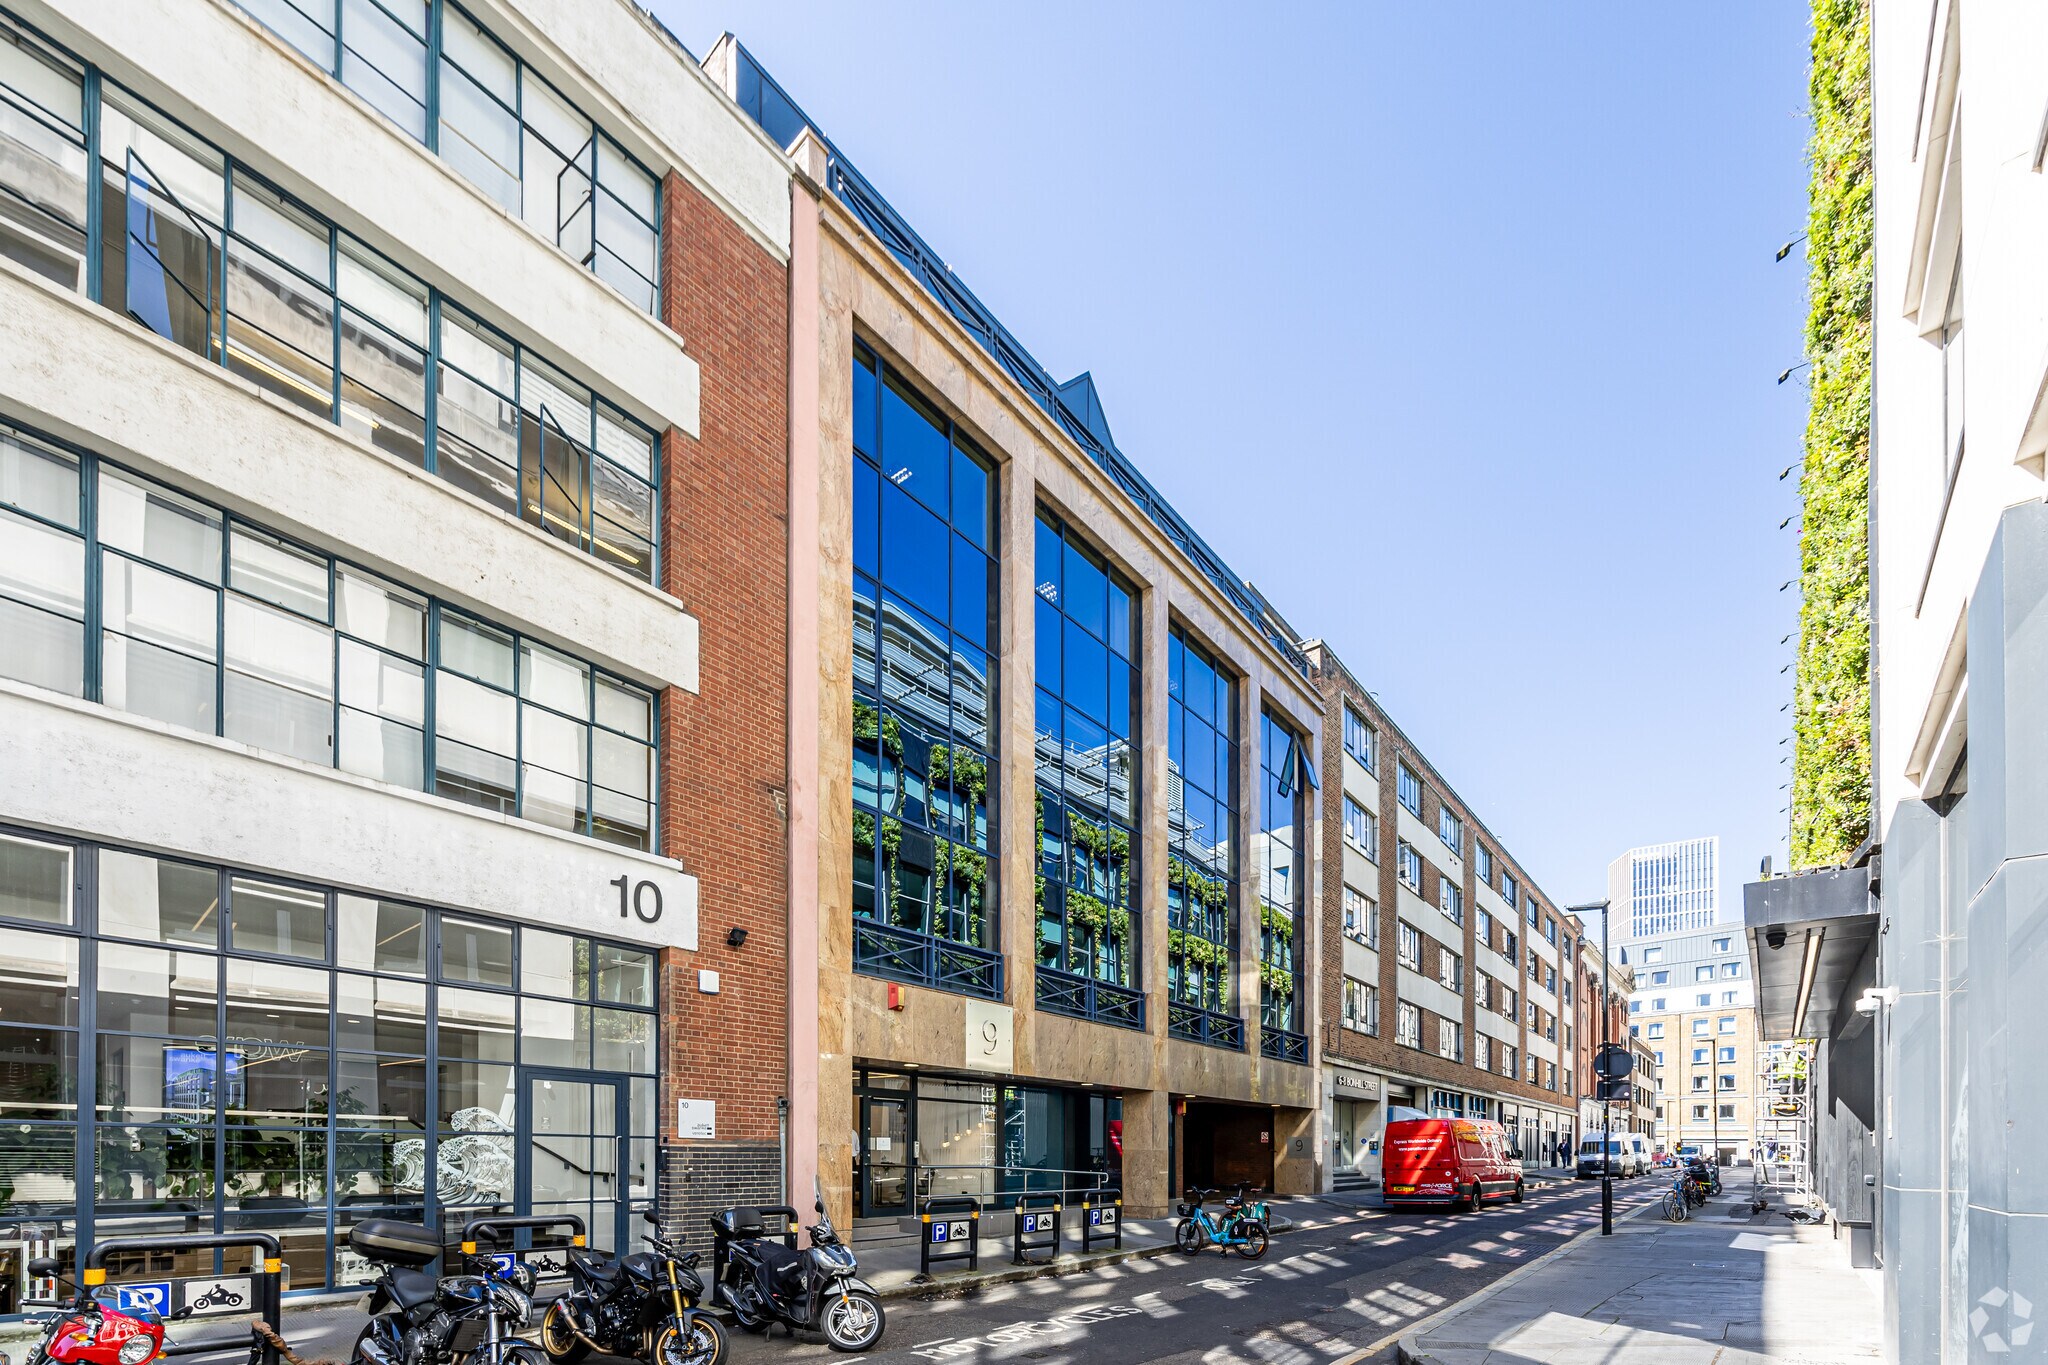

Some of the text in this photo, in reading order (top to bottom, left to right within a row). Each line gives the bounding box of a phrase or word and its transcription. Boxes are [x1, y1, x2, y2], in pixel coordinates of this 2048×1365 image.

[610, 874, 663, 923] 10
[982, 1019, 997, 1055] 9
[1347, 1077, 1364, 1089] BONHILL
[1364, 1080, 1378, 1091] STREET
[1295, 1139, 1304, 1152] 9
[1026, 1216, 1034, 1231] P
[1093, 1211, 1099, 1224] P
[935, 1224, 945, 1241] P
[910, 1305, 1142, 1360] MOTORCYCLES
